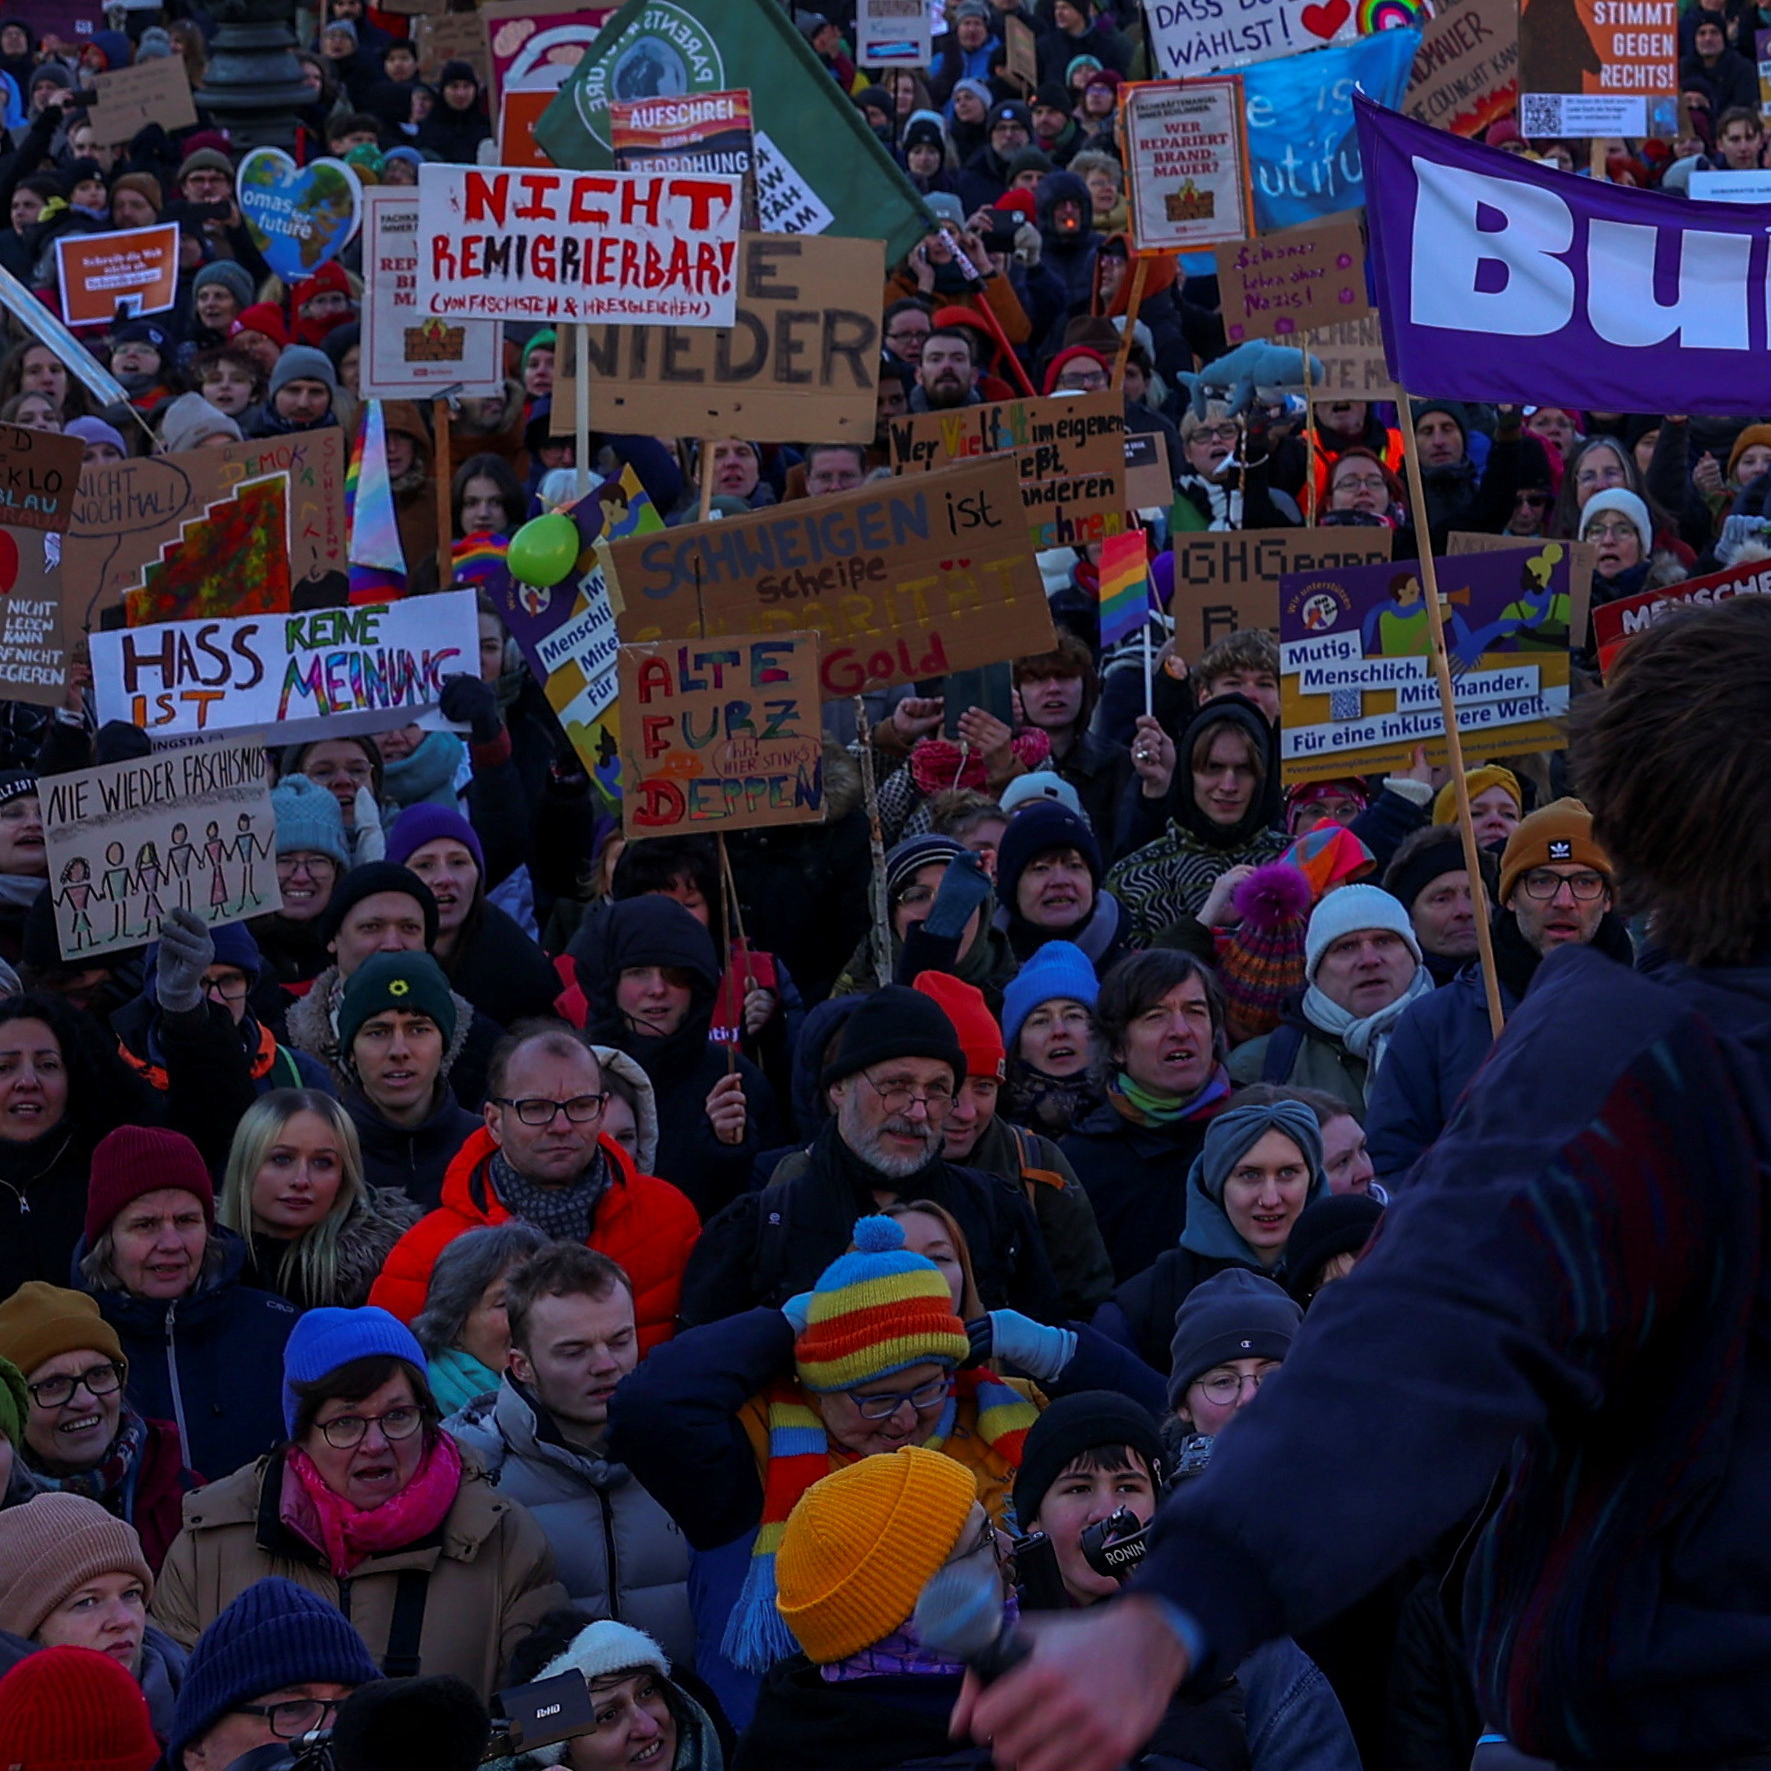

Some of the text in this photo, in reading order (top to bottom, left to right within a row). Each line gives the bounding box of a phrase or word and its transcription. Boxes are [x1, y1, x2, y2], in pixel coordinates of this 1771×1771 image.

[1594, 2, 1675, 26] STIMMT
[1613, 34, 1675, 58] GEGEN
[1601, 63, 1675, 88] RECHTS!
[629, 100, 735, 129] AUFSCHREI
[1163, 121, 1202, 135] WER
[1138, 132, 1230, 151] REPARIERT
[1153, 147, 1217, 164] BRAND-
[1152, 161, 1220, 178] MAUER?
[243, 188, 292, 212] omas
[463, 173, 735, 230] NICHT
[257, 207, 314, 241] future
[431, 234, 737, 296] REMIGRIERBAR!
[562, 295, 578, 316] &
[1031, 411, 1055, 444] im
[1056, 406, 1126, 450] eigenen
[640, 488, 1004, 601] SCHWEIGEN ist
[7, 598, 59, 618] NICHT
[122, 604, 390, 697] HASS KEINE
[820, 630, 951, 695] Gold
[1288, 640, 1358, 667] Mutig.
[130, 645, 463, 730] IST MEINUNG
[638, 641, 796, 704] ALTE
[1303, 662, 1424, 688] Menschlich.
[587, 677, 614, 708] Für
[642, 699, 802, 760] FURZ
[1292, 696, 1551, 754] Für eine Welt.
[47, 743, 268, 827] NIE WIEDER FASCHISMUS
[633, 756, 825, 827] DEPPEN
